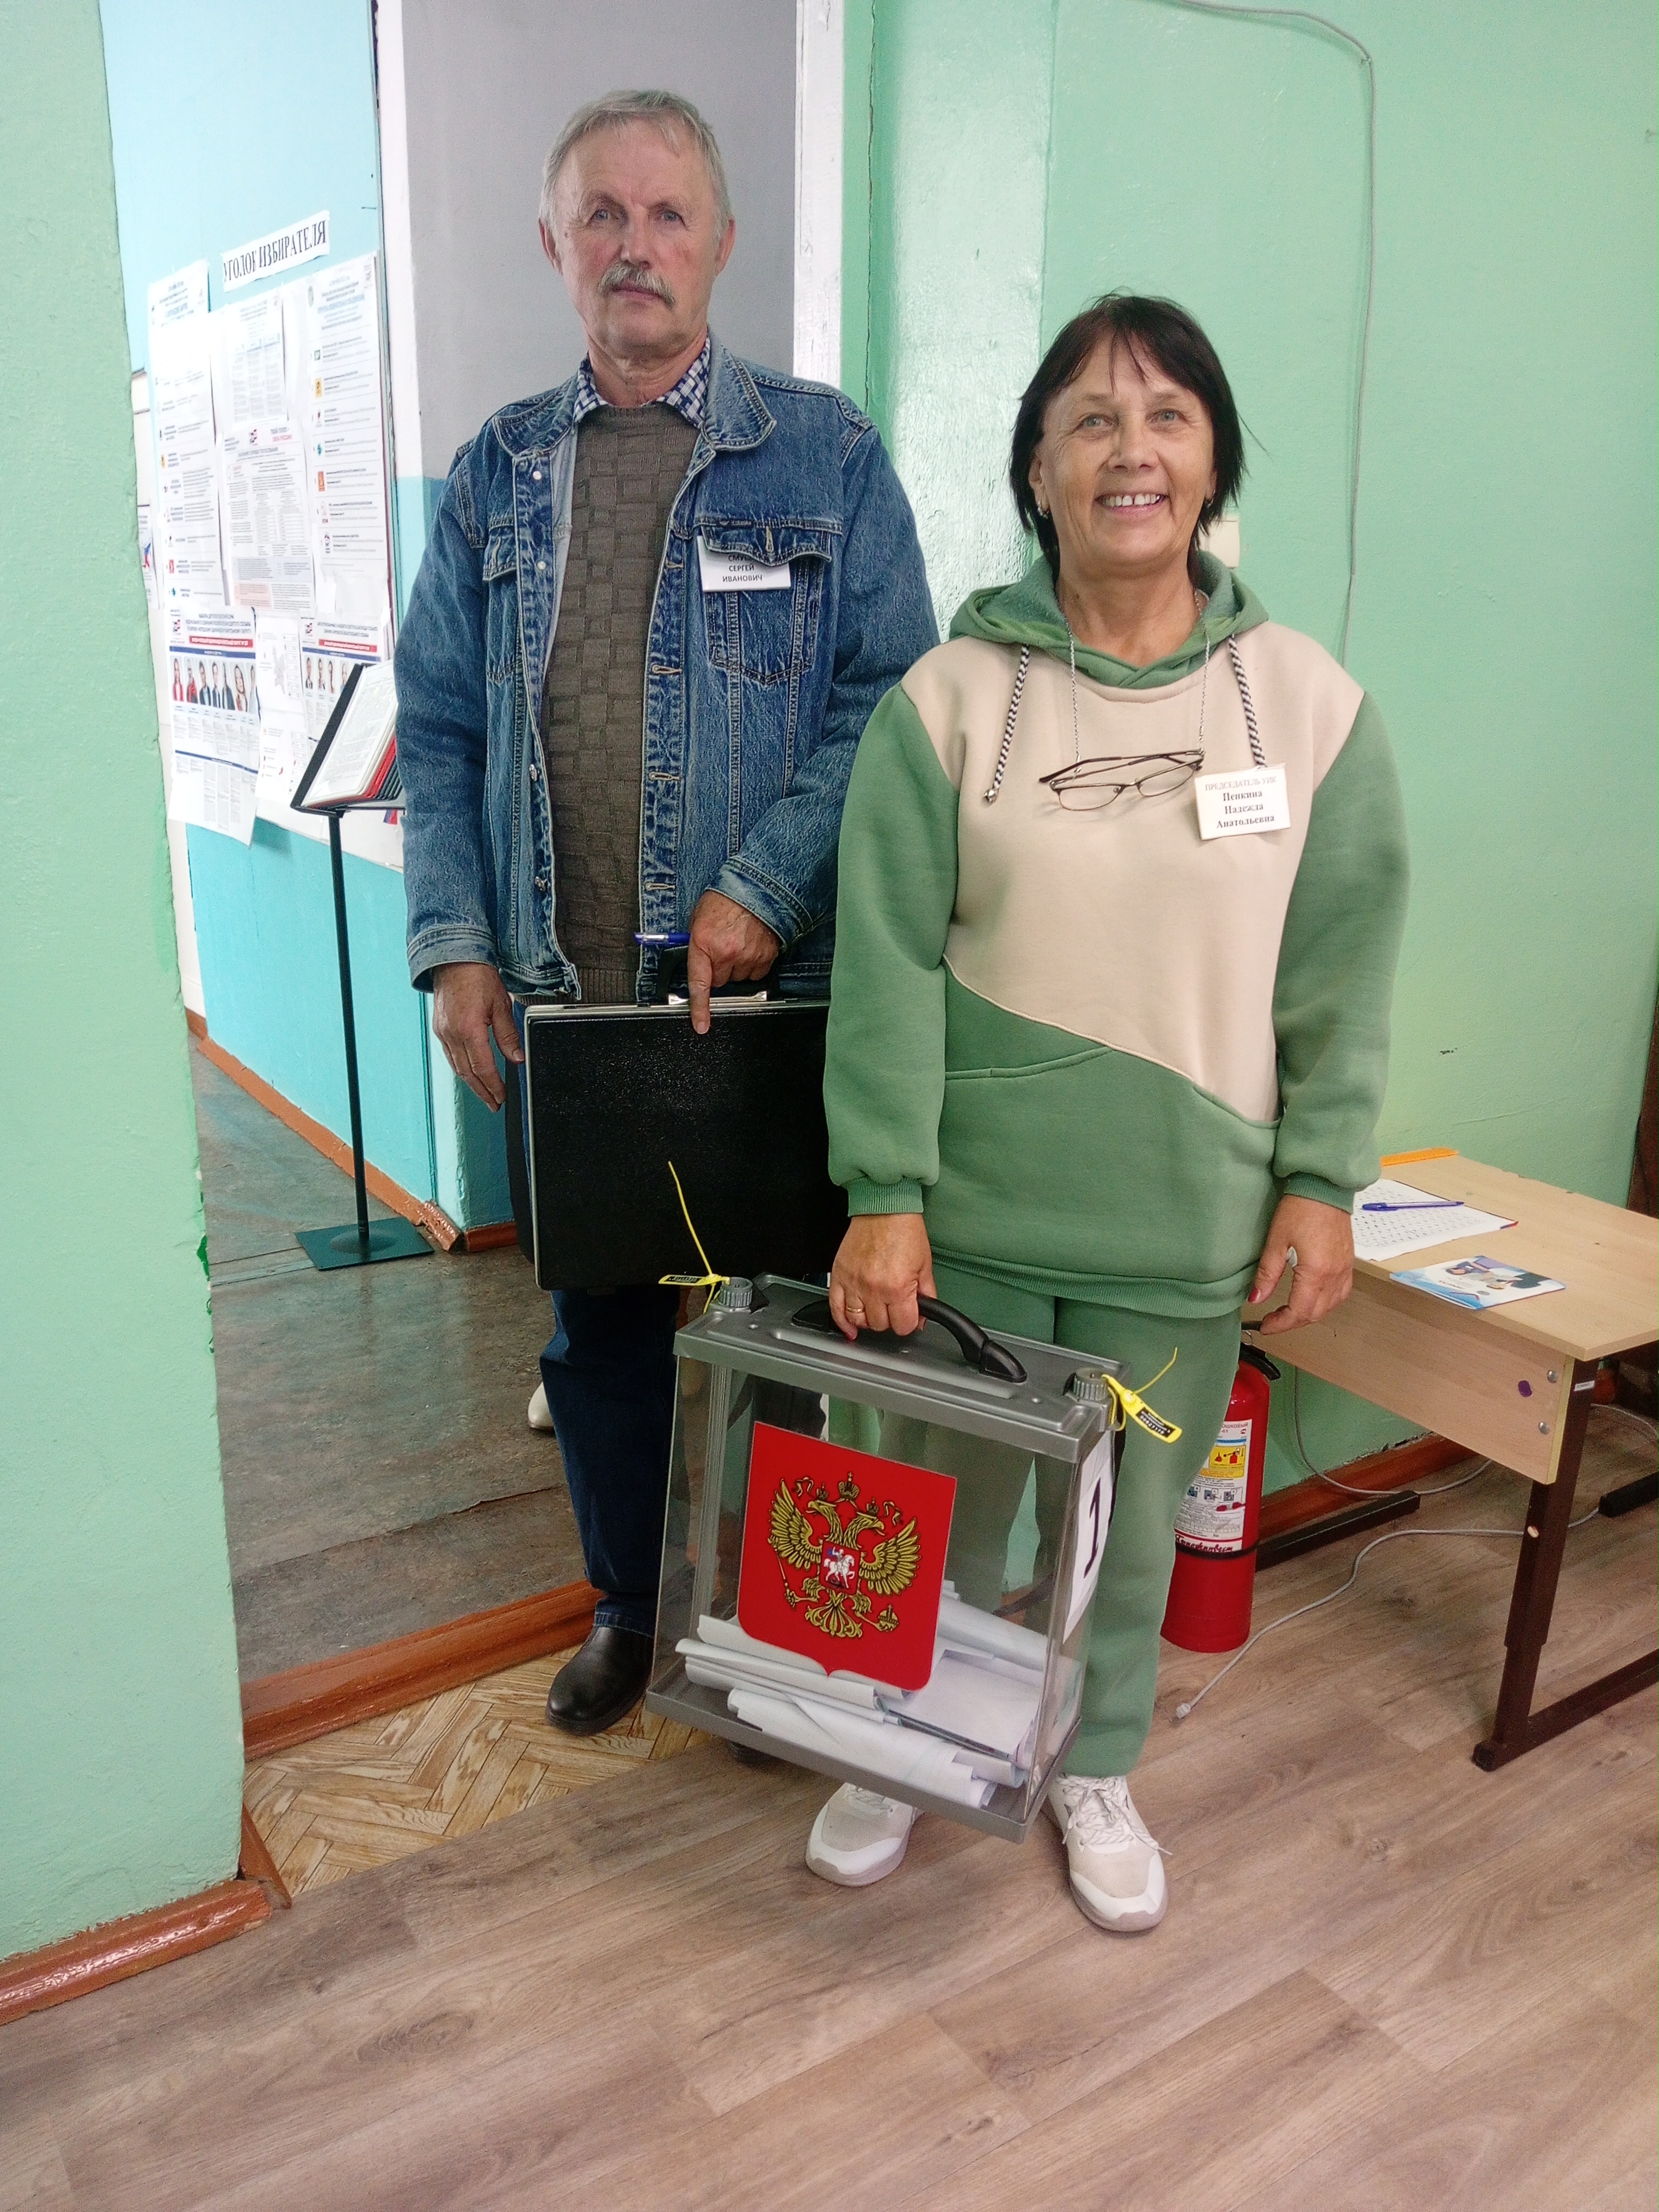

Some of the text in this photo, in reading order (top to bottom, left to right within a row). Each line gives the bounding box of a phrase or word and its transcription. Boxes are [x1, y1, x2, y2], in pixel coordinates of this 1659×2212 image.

[224, 220, 327, 282] УГОЛОК ИЗБИРАТЕЛЯ
[729, 563, 754, 572] СЕРГЕЙ
[1205, 776, 1276, 791] ПРЕДСЕДАТЕЛЬ УИК
[1223, 791, 1263, 802] Пенкина
[1225, 804, 1263, 814] Надежда
[1216, 815, 1275, 829] Анатольевна
[1084, 1477, 1101, 1578] 1
